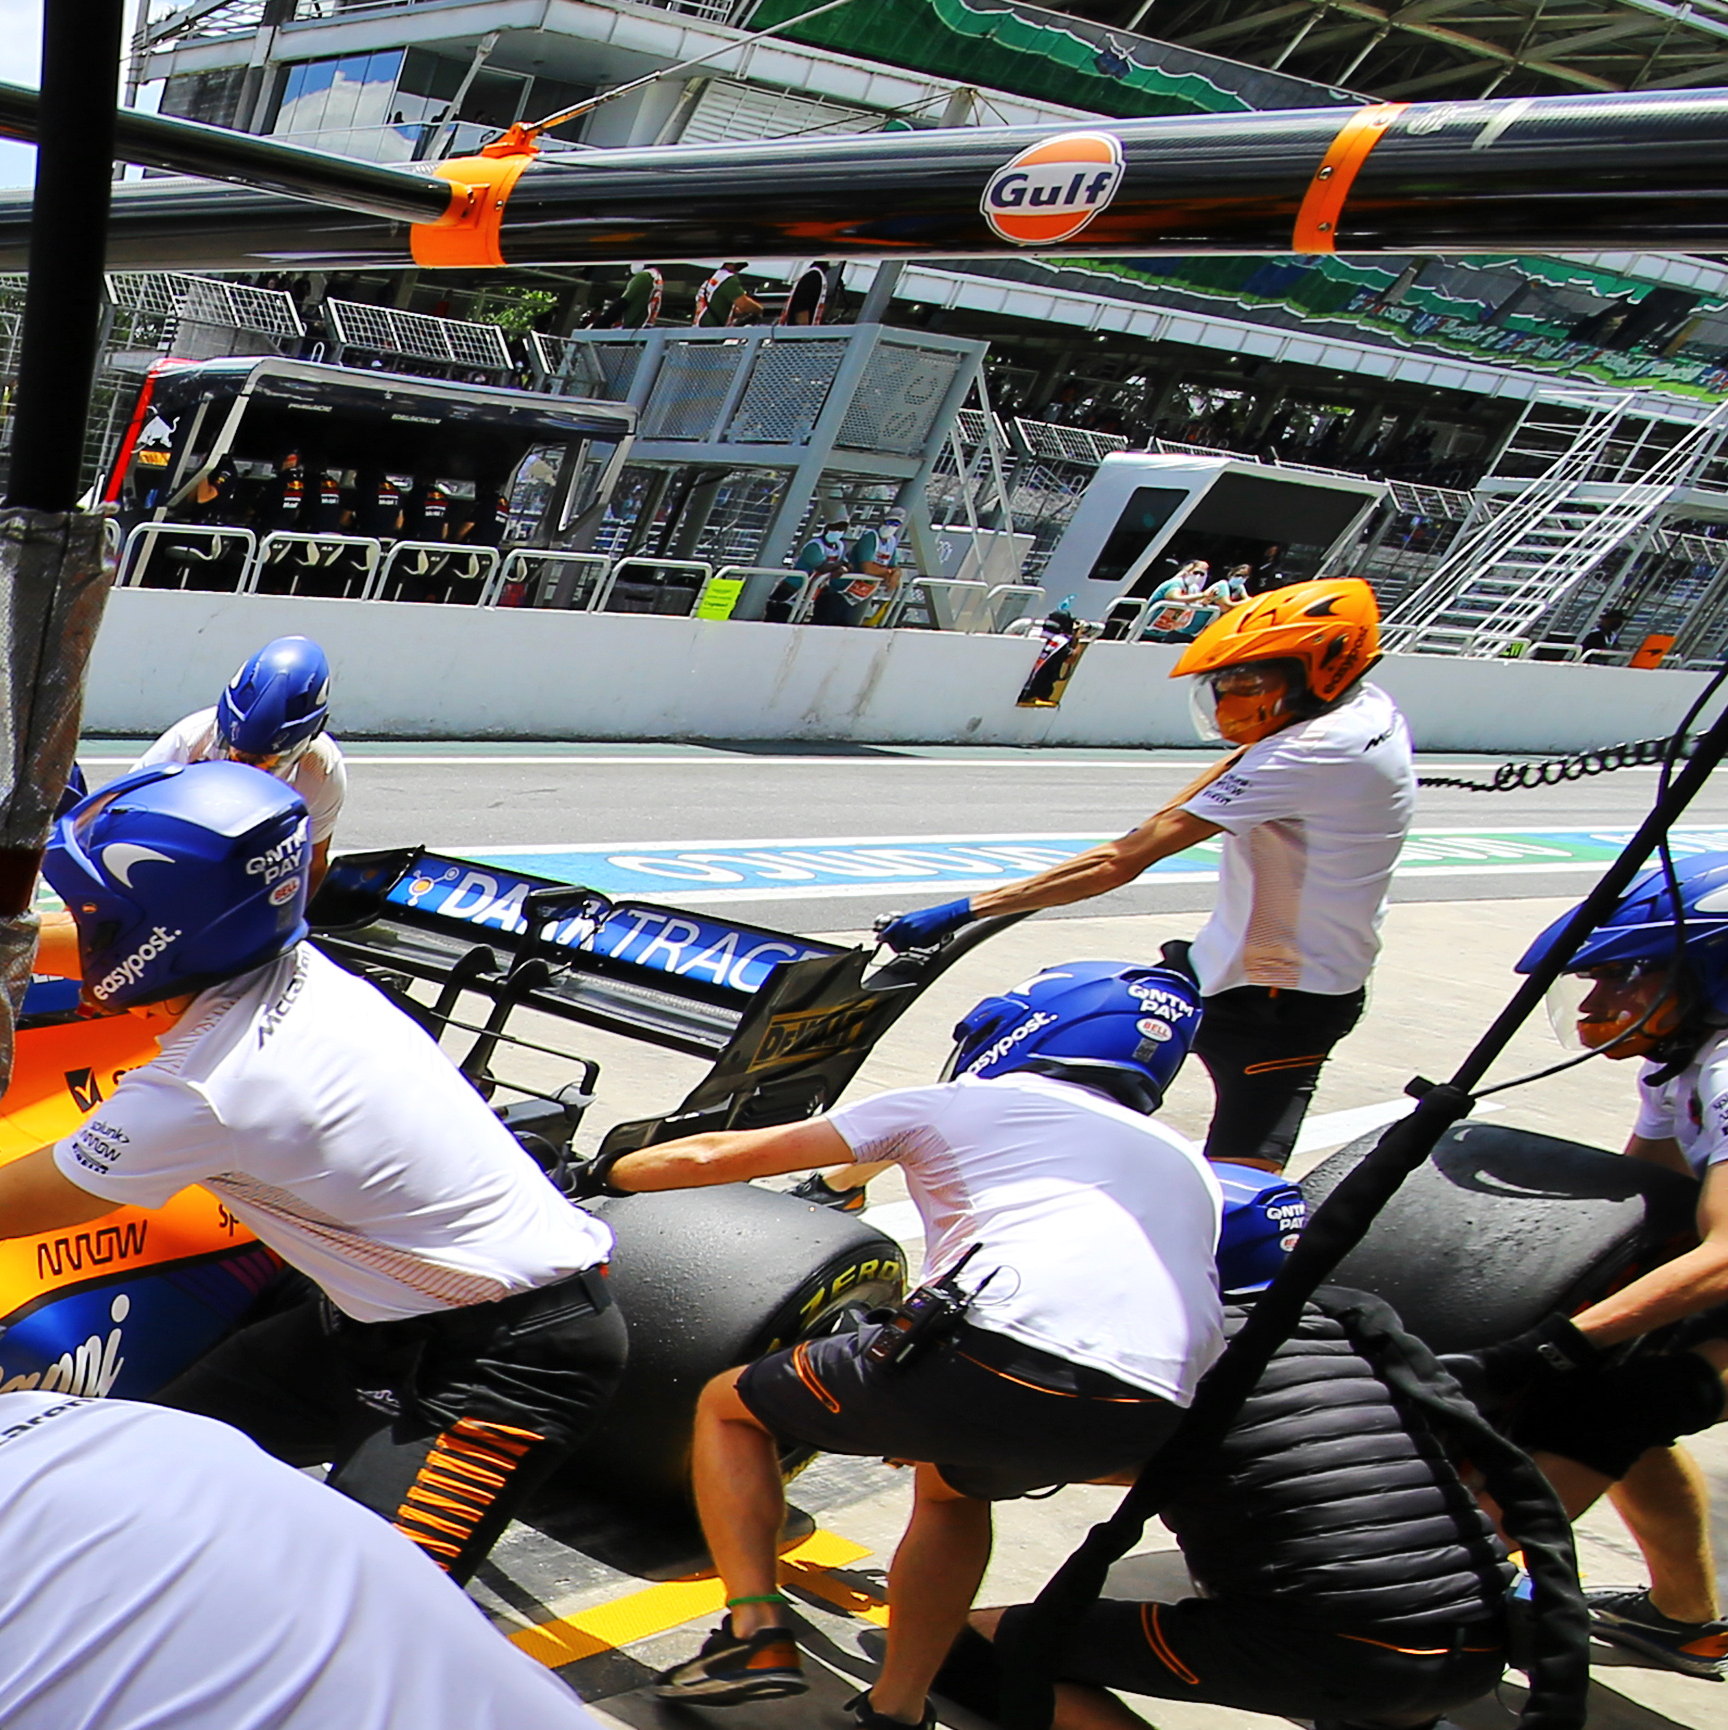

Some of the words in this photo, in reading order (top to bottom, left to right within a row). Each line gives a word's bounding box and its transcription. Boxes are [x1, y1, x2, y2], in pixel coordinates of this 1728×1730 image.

[990, 172, 1113, 208] Gulf
[264, 849, 304, 886] PAY
[92, 926, 183, 1001] easypost.
[1127, 983, 1195, 1018] QNTM
[1140, 1000, 1183, 1023] PAY
[965, 1009, 1059, 1075] asypost.
[1141, 1020, 1169, 1039] BELL
